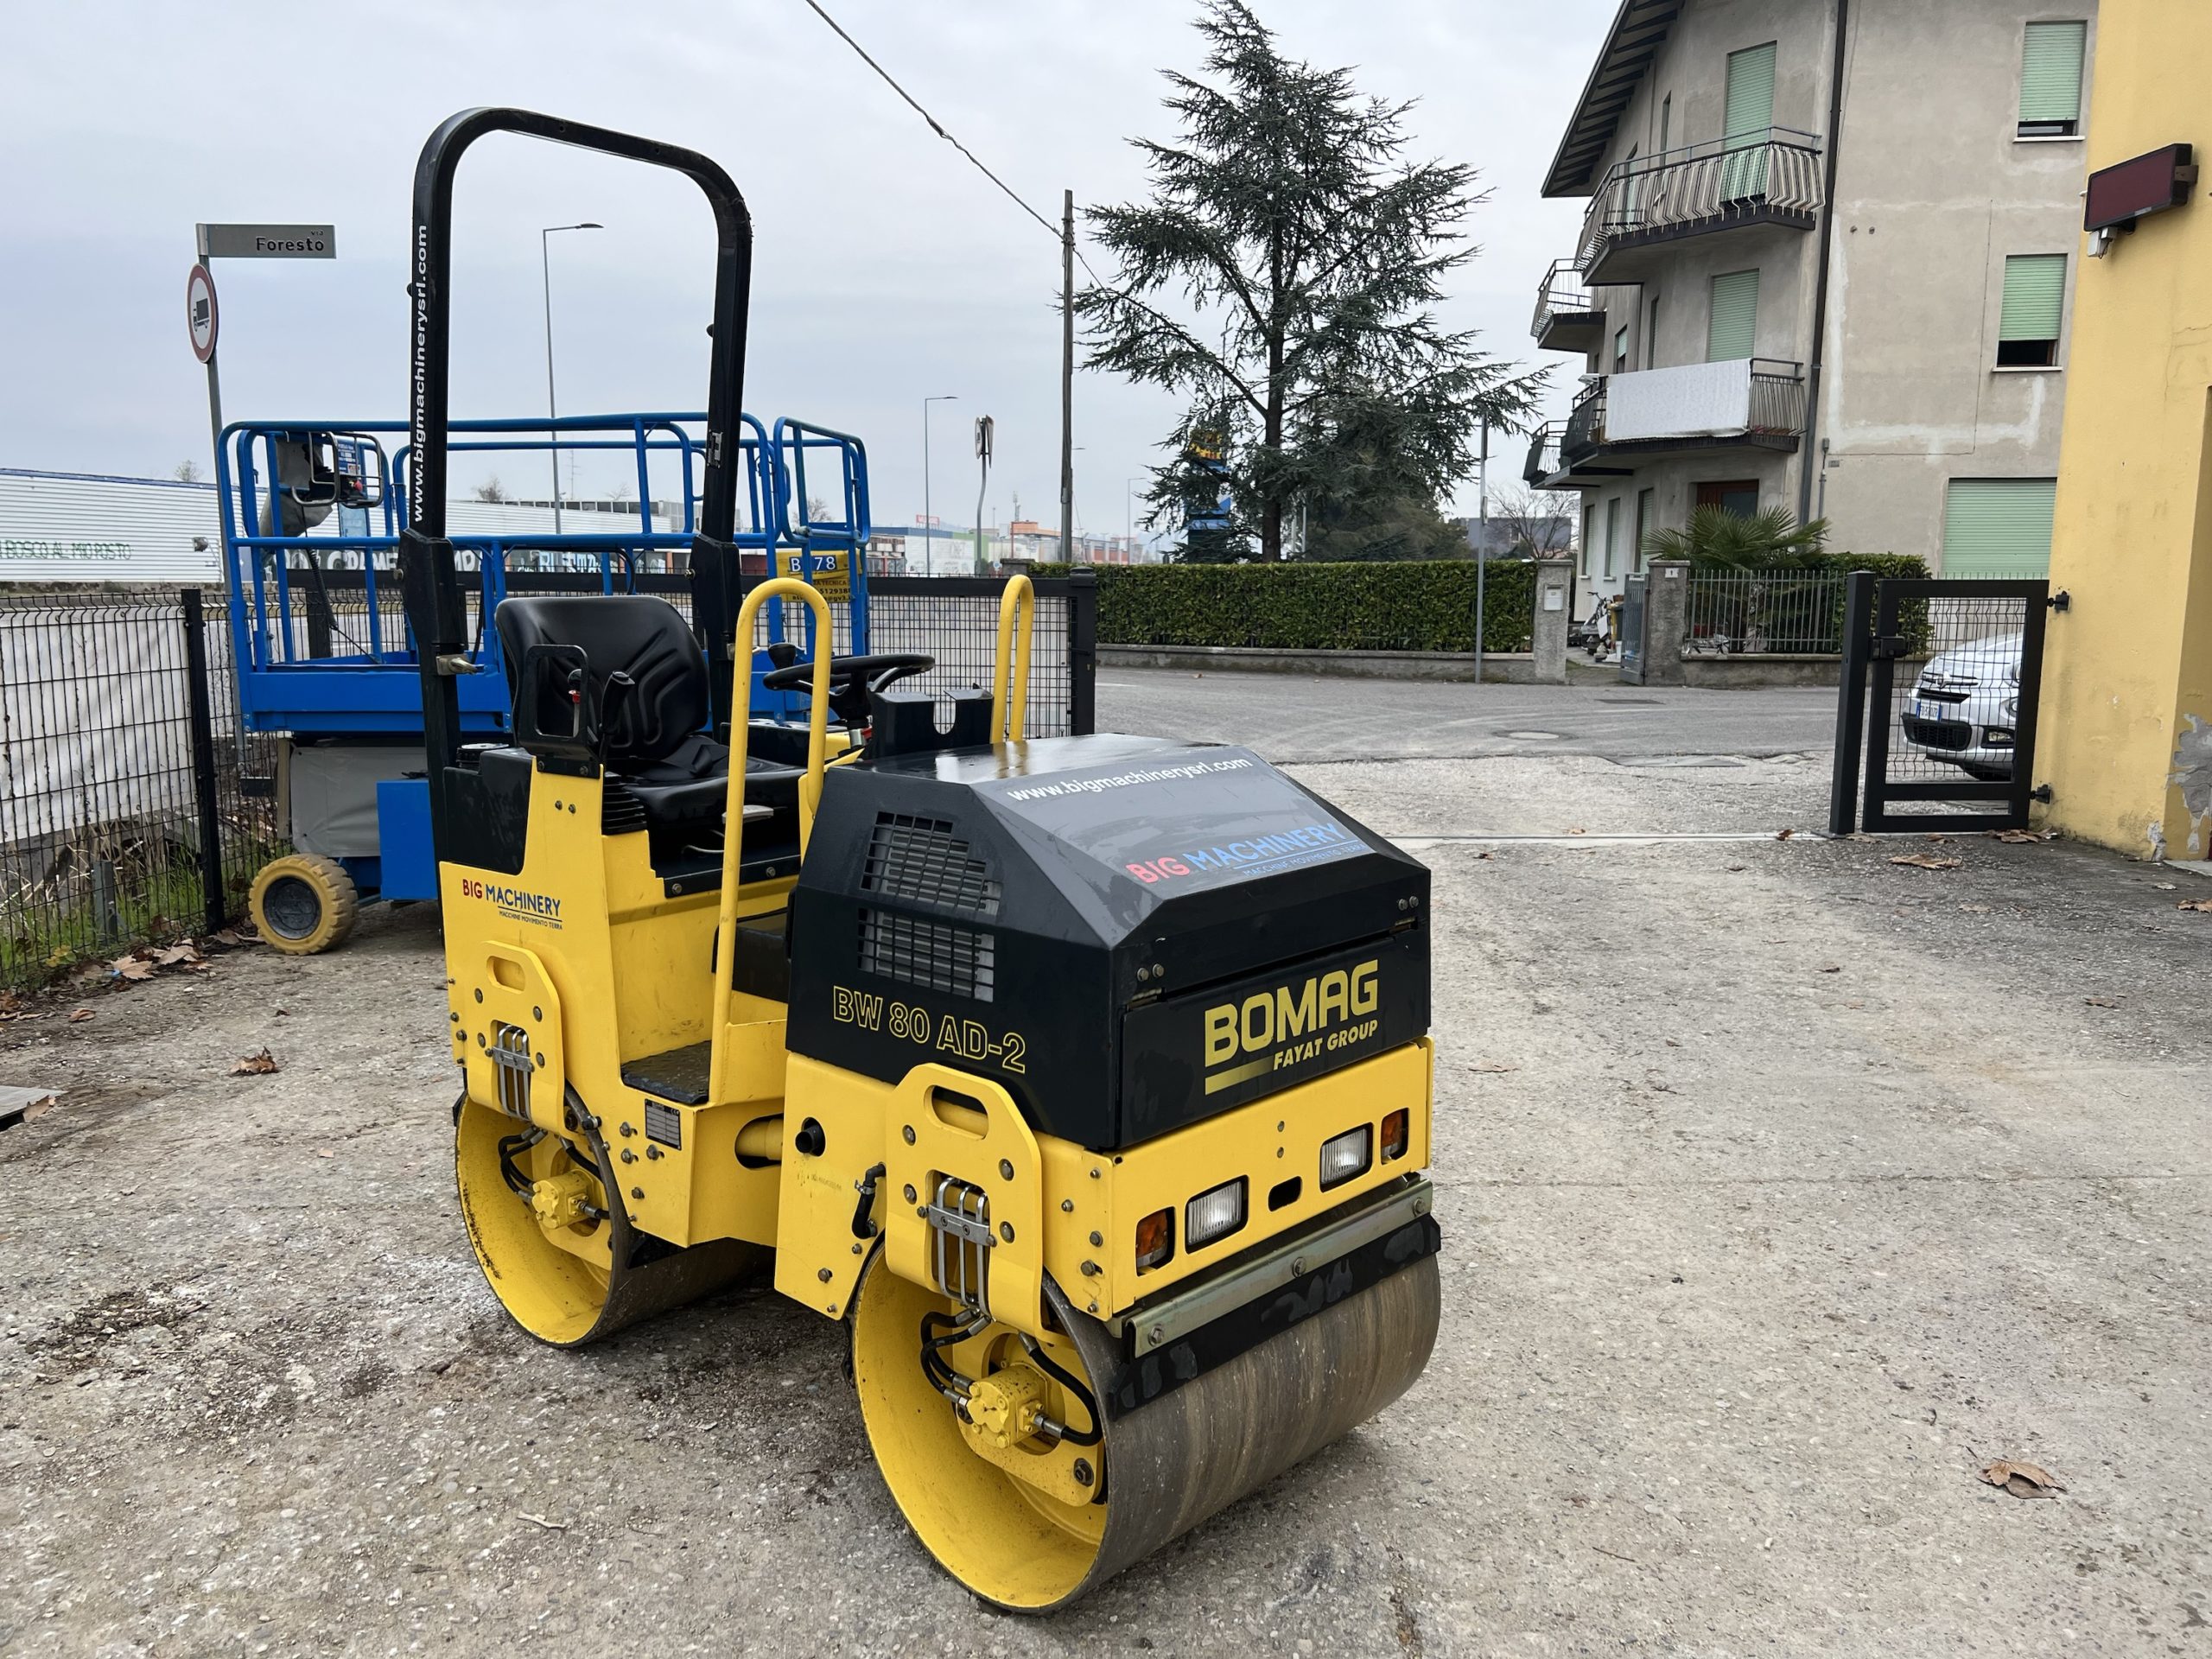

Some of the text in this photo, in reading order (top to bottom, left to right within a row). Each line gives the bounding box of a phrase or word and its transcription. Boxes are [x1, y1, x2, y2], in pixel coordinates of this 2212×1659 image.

[256, 236, 324, 251] Foresto
[414, 225, 428, 522] www.bigmachinerysrl.com
[1007, 757, 1253, 802] www.bigmachinerysrl.com
[1125, 823, 1346, 884] BIG MACHINERY
[1243, 861, 1289, 877] MACCHINE
[1290, 849, 1342, 866] MOVIMENTO
[462, 879, 561, 917] BIG MACHINERY
[499, 910, 563, 931] MACCHINE MOVIMENTO TERRA
[833, 985, 1026, 1075] BW 80 AD-2
[1205, 958, 1378, 1068] BOMAG
[1273, 1019, 1378, 1071] FAYAT GROUP
